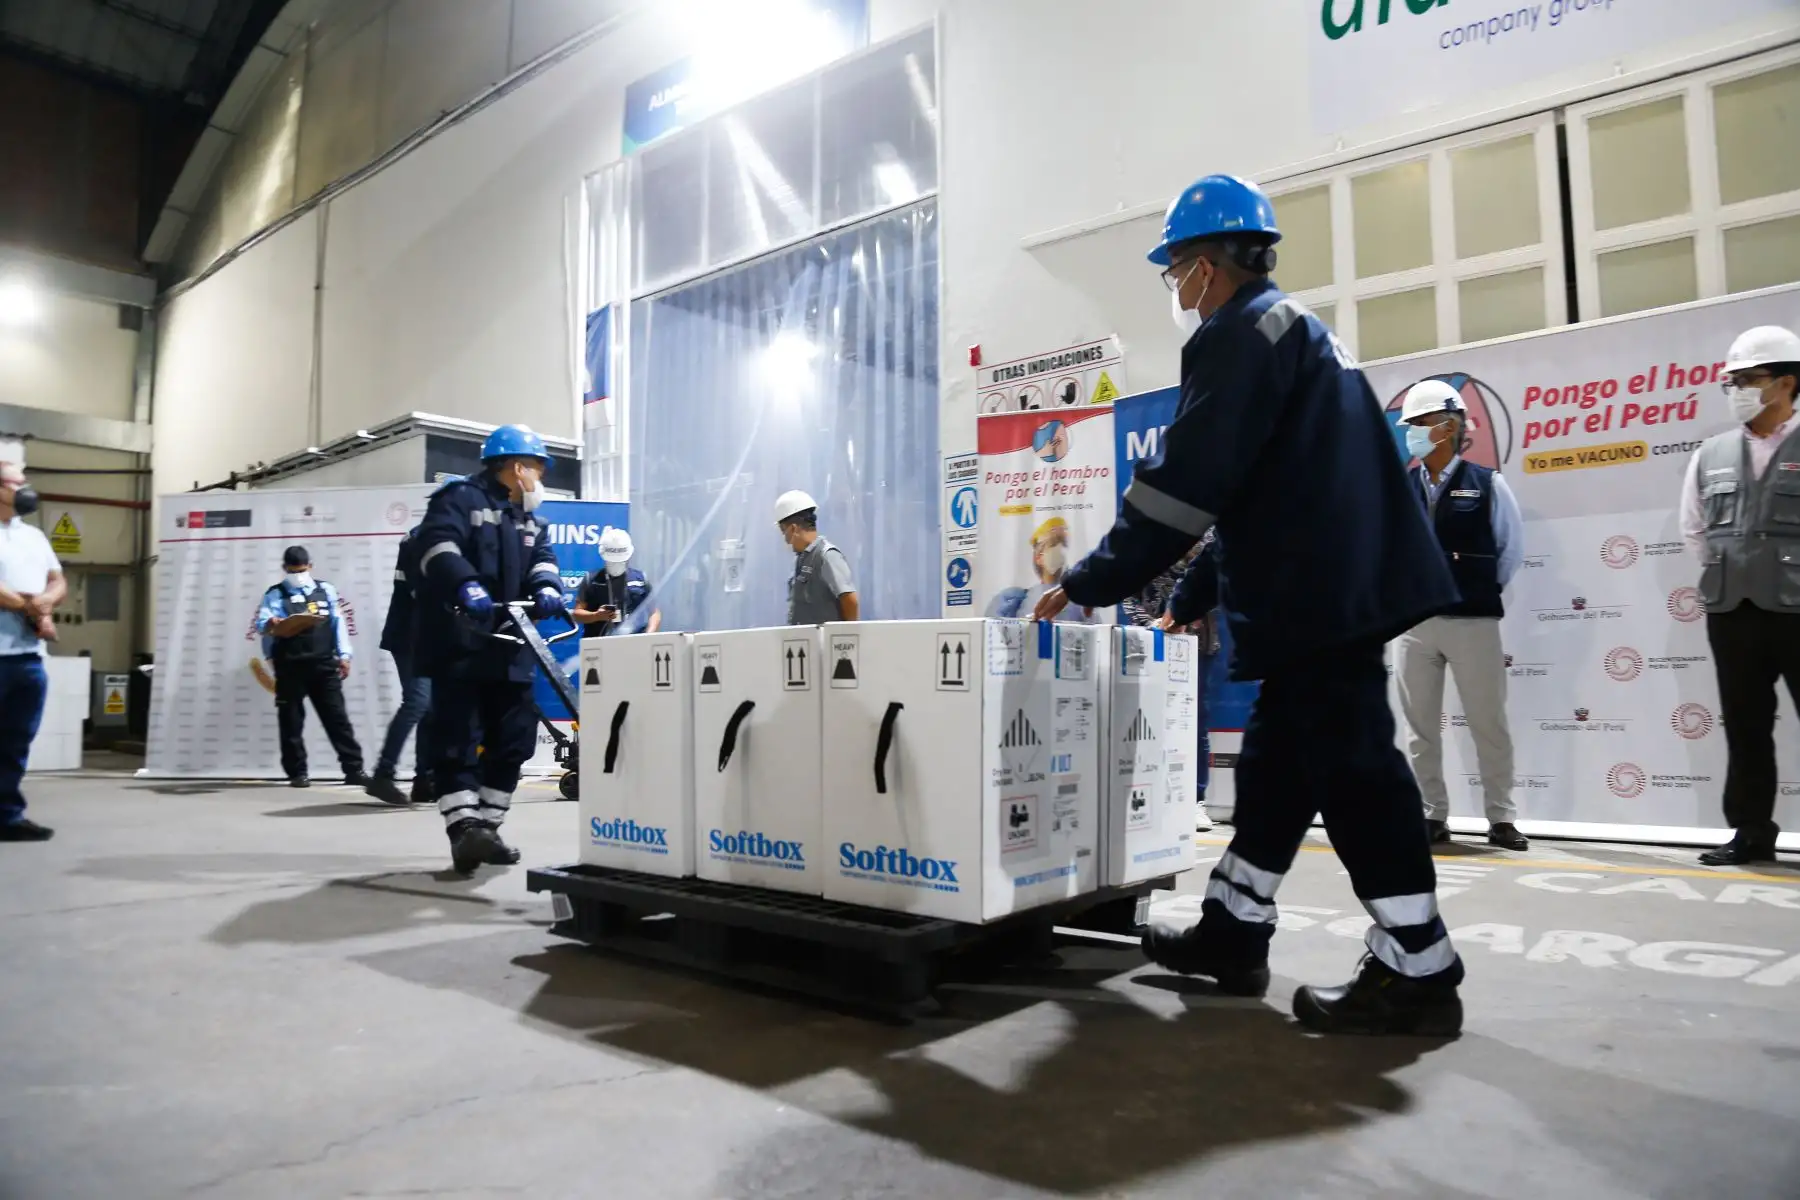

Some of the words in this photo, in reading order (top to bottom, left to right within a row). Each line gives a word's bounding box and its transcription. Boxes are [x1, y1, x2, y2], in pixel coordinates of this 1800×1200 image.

[1439, 4, 1542, 49] company
[993, 364, 1025, 382] OTRAS
[1028, 345, 1103, 375] INDICACIONES
[1522, 379, 1618, 410] Pongo
[1628, 366, 1659, 394] el
[1522, 415, 1578, 448] por
[1584, 405, 1613, 433] el
[1620, 392, 1699, 429] Perú
[1528, 457, 1547, 470] Yo
[1551, 455, 1574, 467] me
[1577, 445, 1644, 465] VACUNO
[985, 471, 1028, 486] Pongo
[1032, 467, 1046, 481] el
[1050, 465, 1109, 480] hombro
[1005, 487, 1030, 502] por
[1033, 483, 1047, 497] el
[1052, 480, 1087, 496] Perú
[833, 643, 855, 651] HEAVY
[590, 816, 669, 846] Softbox
[709, 829, 805, 862] Softbox
[840, 842, 959, 883] Softbox
